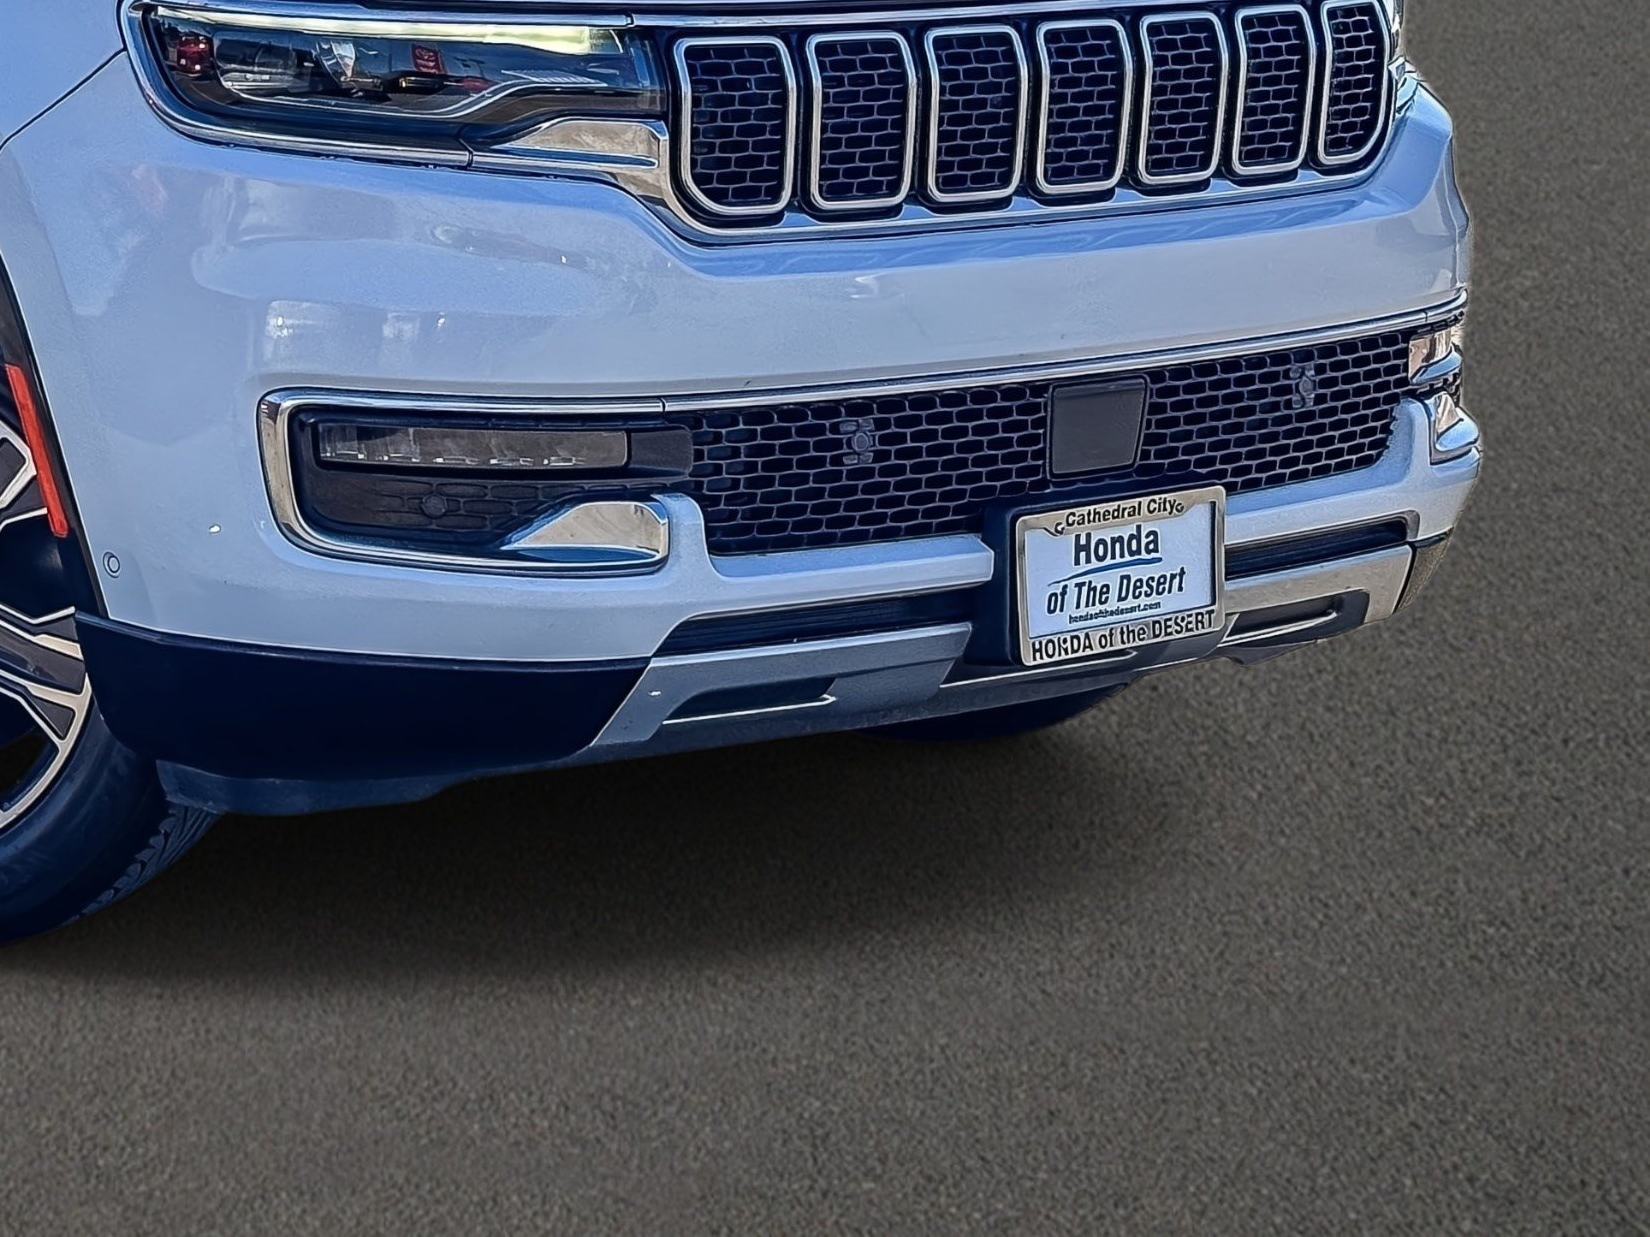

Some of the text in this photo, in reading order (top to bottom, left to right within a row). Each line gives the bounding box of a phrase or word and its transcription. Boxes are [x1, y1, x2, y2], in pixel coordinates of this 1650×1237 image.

[1065, 496, 1177, 528] Cathedral City
[1073, 524, 1160, 566] Honda
[1046, 567, 1186, 615] of The Desert
[1031, 609, 1215, 661] HONDA of the DESERT
